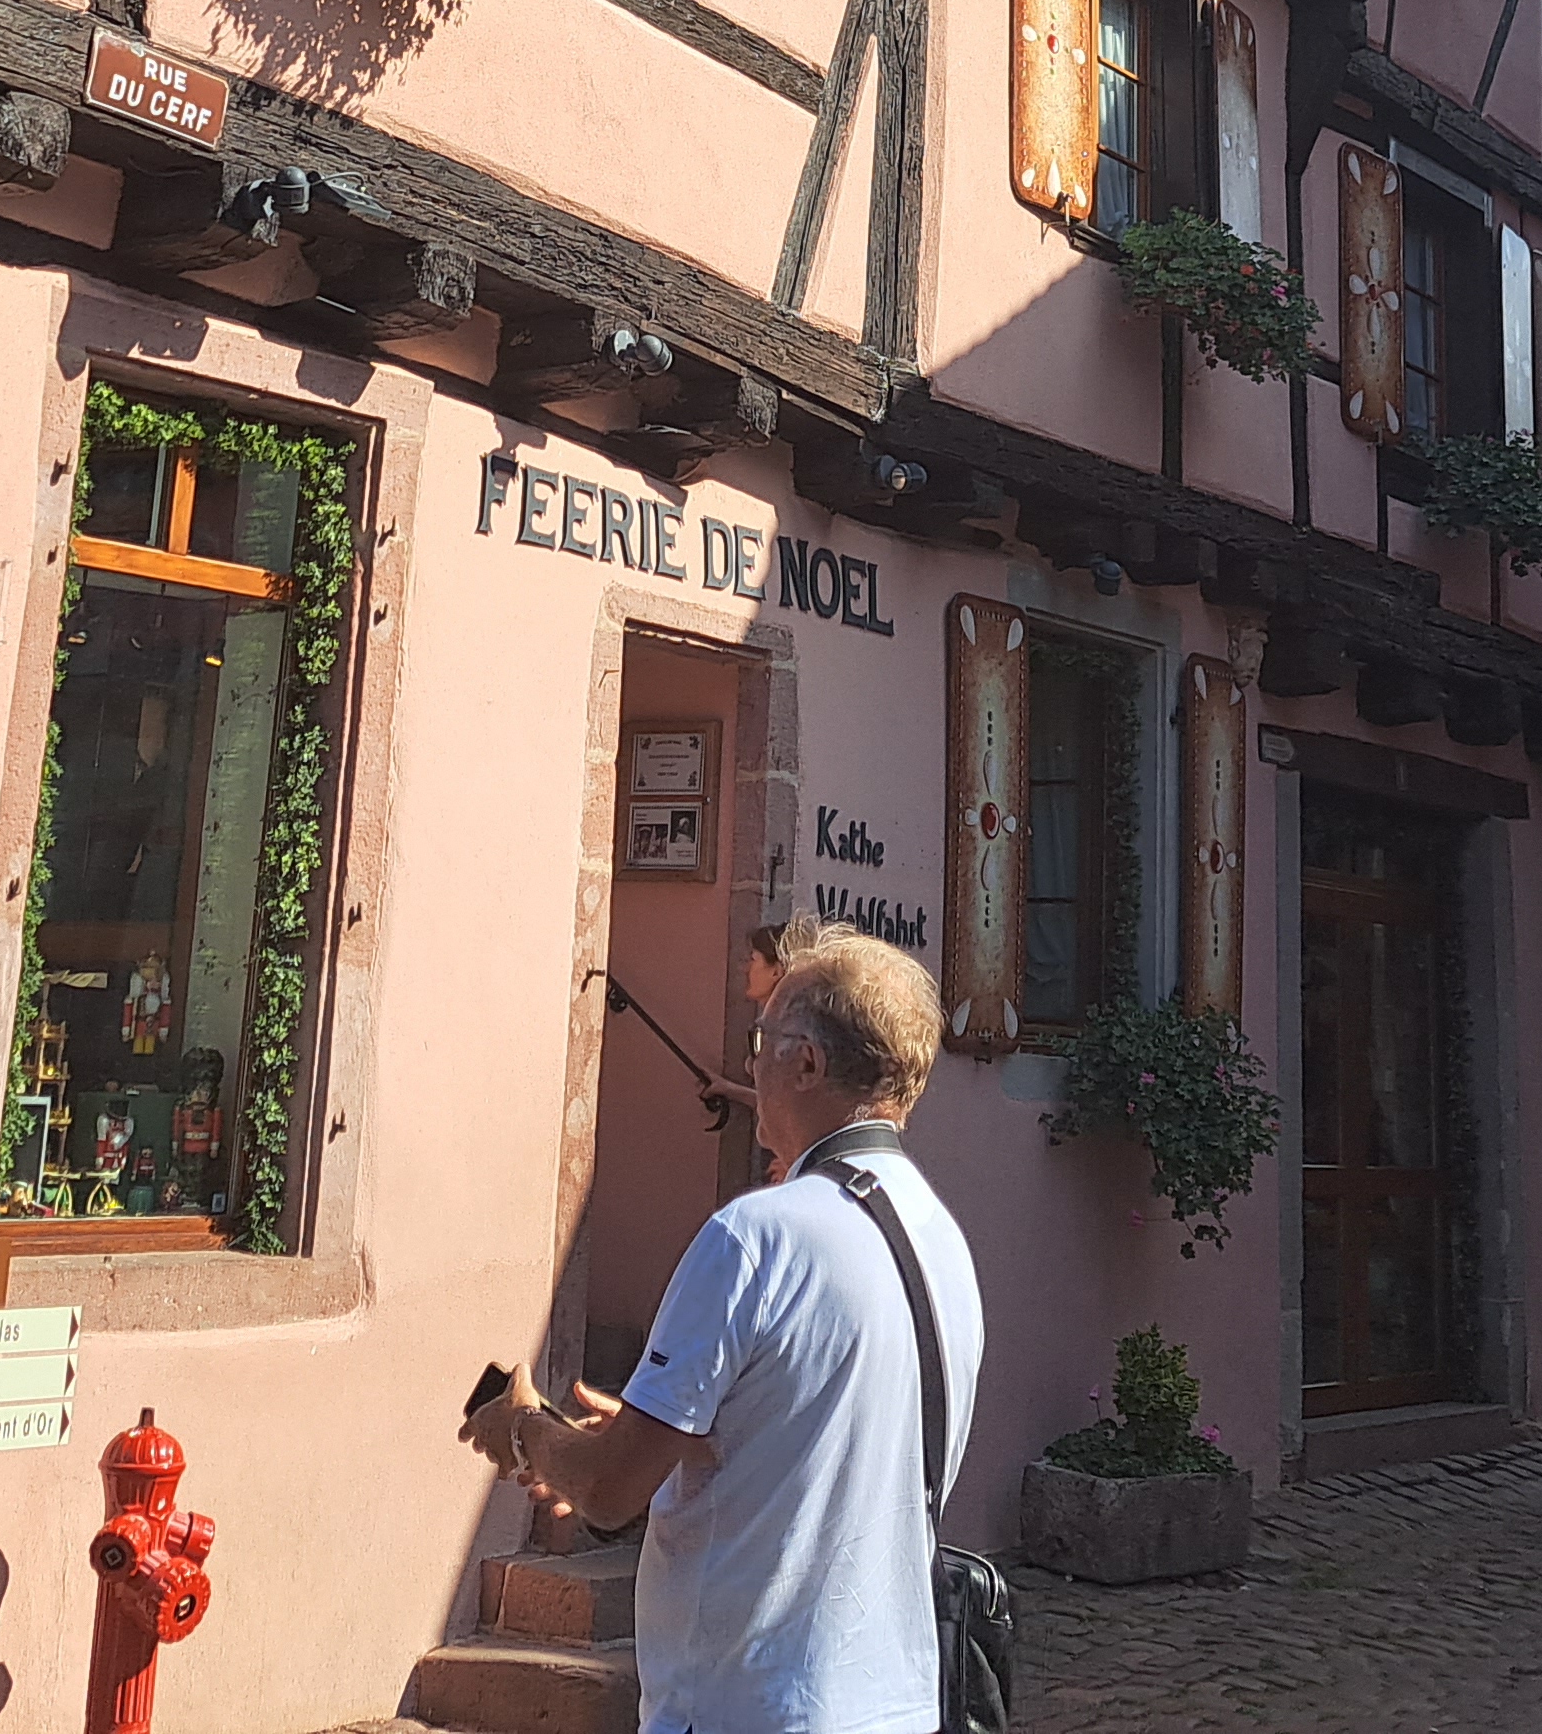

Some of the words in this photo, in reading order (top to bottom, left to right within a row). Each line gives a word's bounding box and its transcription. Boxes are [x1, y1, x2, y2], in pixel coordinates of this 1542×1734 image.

[109, 74, 144, 107] DU
[150, 91, 212, 132] CERF
[144, 58, 188, 92] RUE
[475, 453, 687, 581] FEERIE
[701, 516, 766, 600] DE
[777, 536, 895, 637] NOEL
[816, 805, 885, 868] Kathe
[23, 1412, 54, 1436] d'Or
